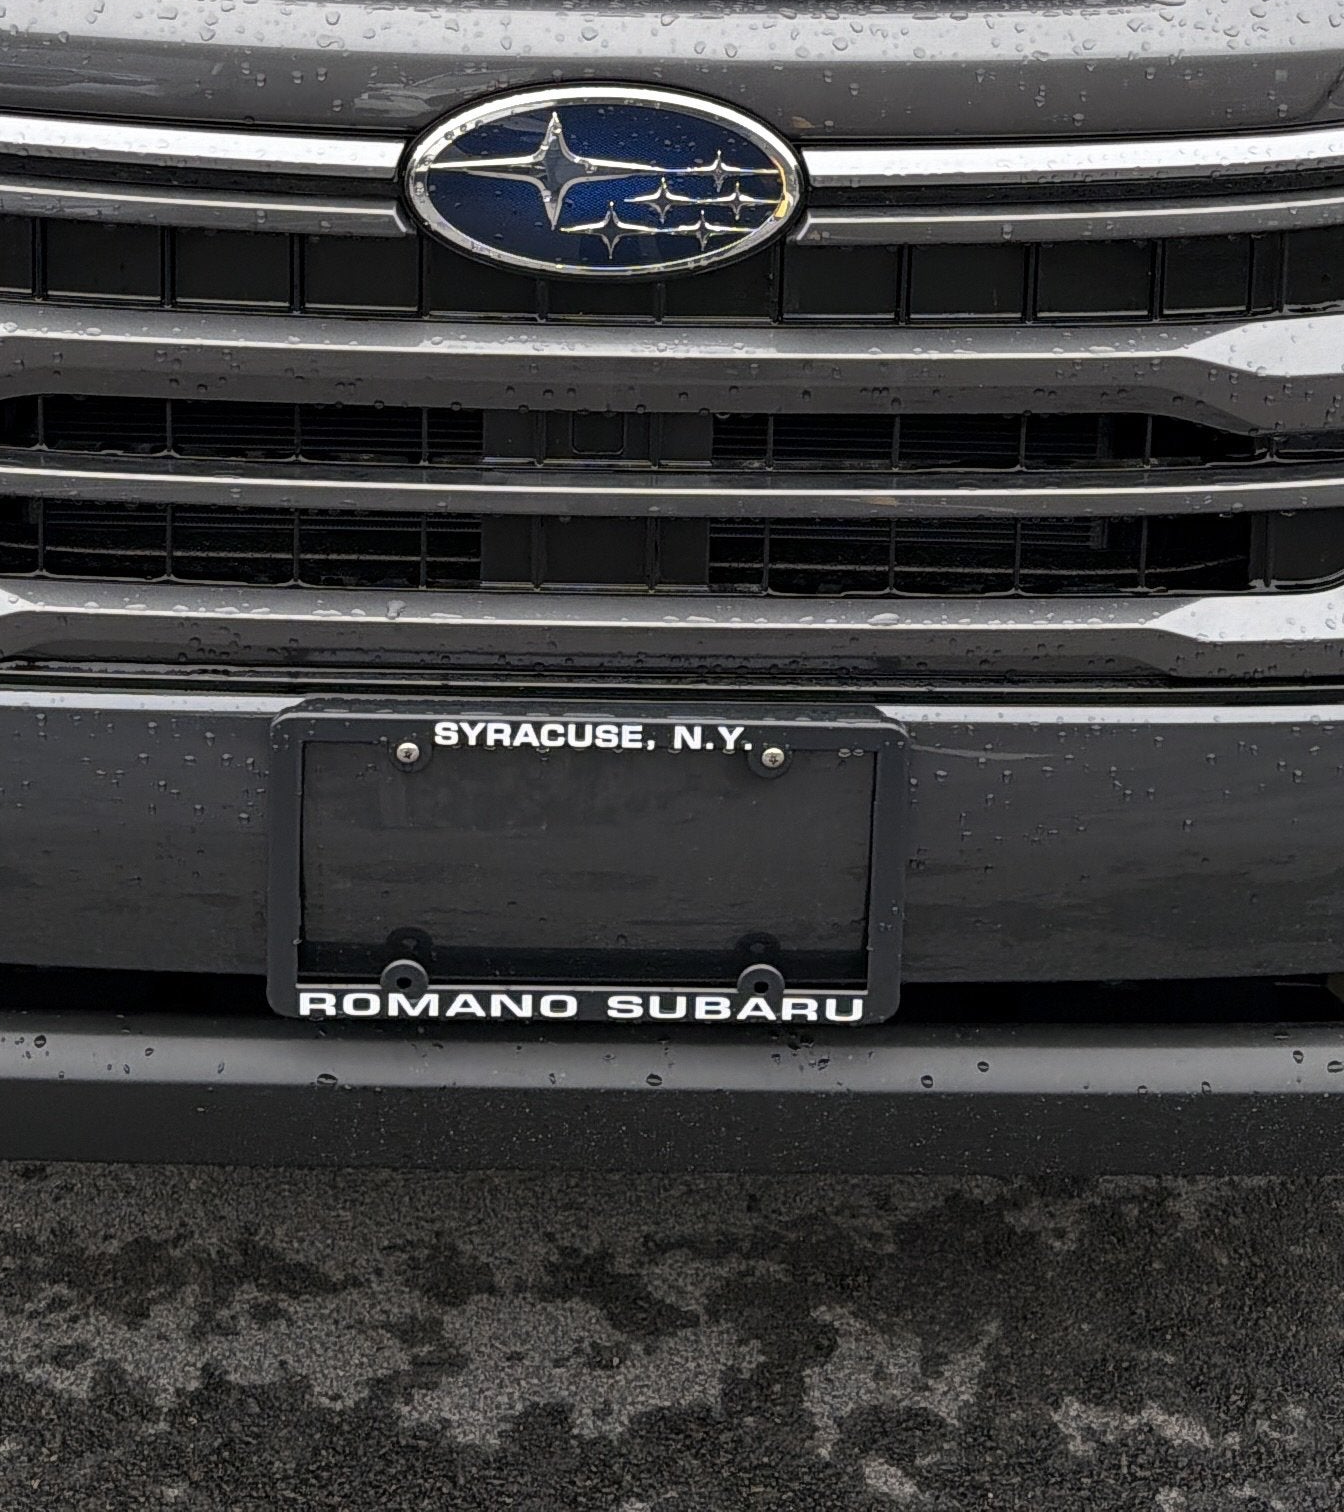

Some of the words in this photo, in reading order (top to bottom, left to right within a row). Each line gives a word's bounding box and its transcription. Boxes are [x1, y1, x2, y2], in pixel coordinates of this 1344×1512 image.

[433, 721, 656, 751] SYRACUSE,
[673, 726, 753, 751] N.Y.
[298, 992, 578, 1019] ROMANO
[606, 994, 863, 1022] SUBARU
